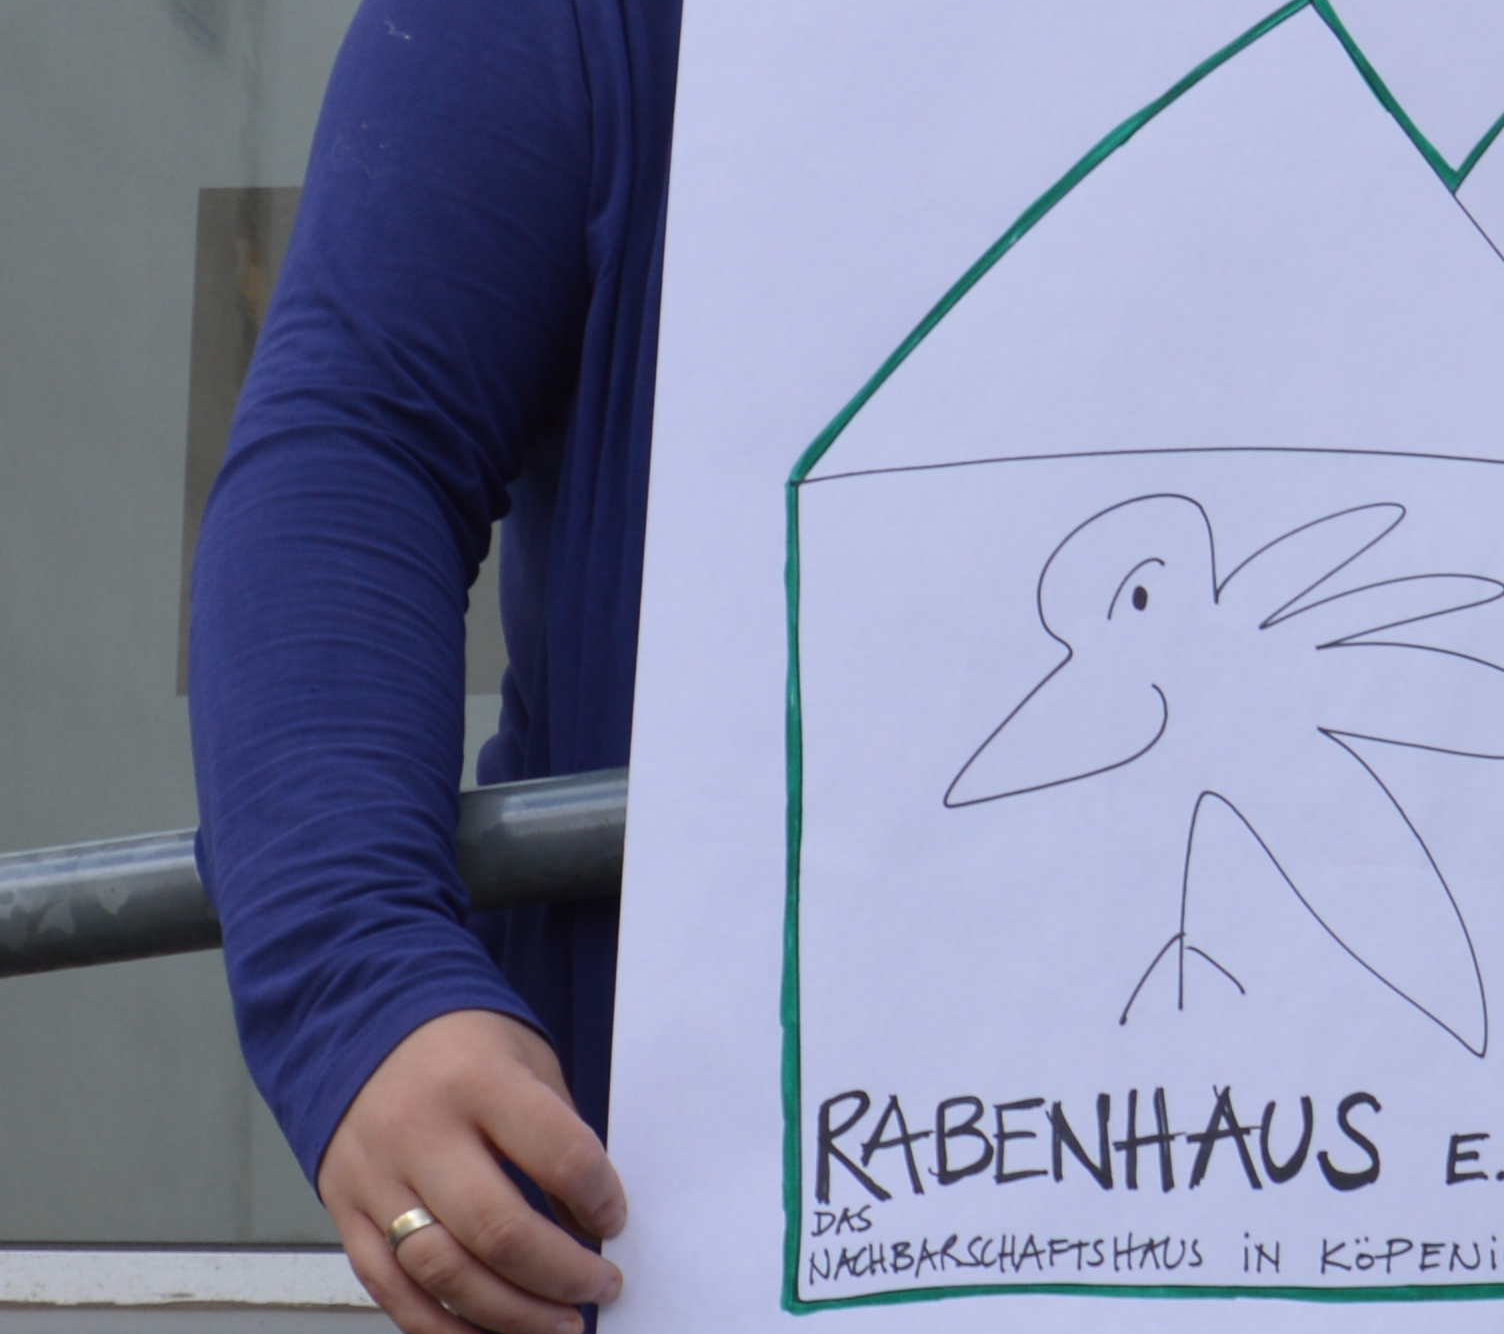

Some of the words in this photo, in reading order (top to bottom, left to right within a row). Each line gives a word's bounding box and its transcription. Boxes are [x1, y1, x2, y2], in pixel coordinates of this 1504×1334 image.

[814, 1085, 1382, 1204] RABENHAUS
[811, 1205, 874, 1235] DAS
[808, 1231, 1205, 1286] NACHBARSCHAFTSHAUS
